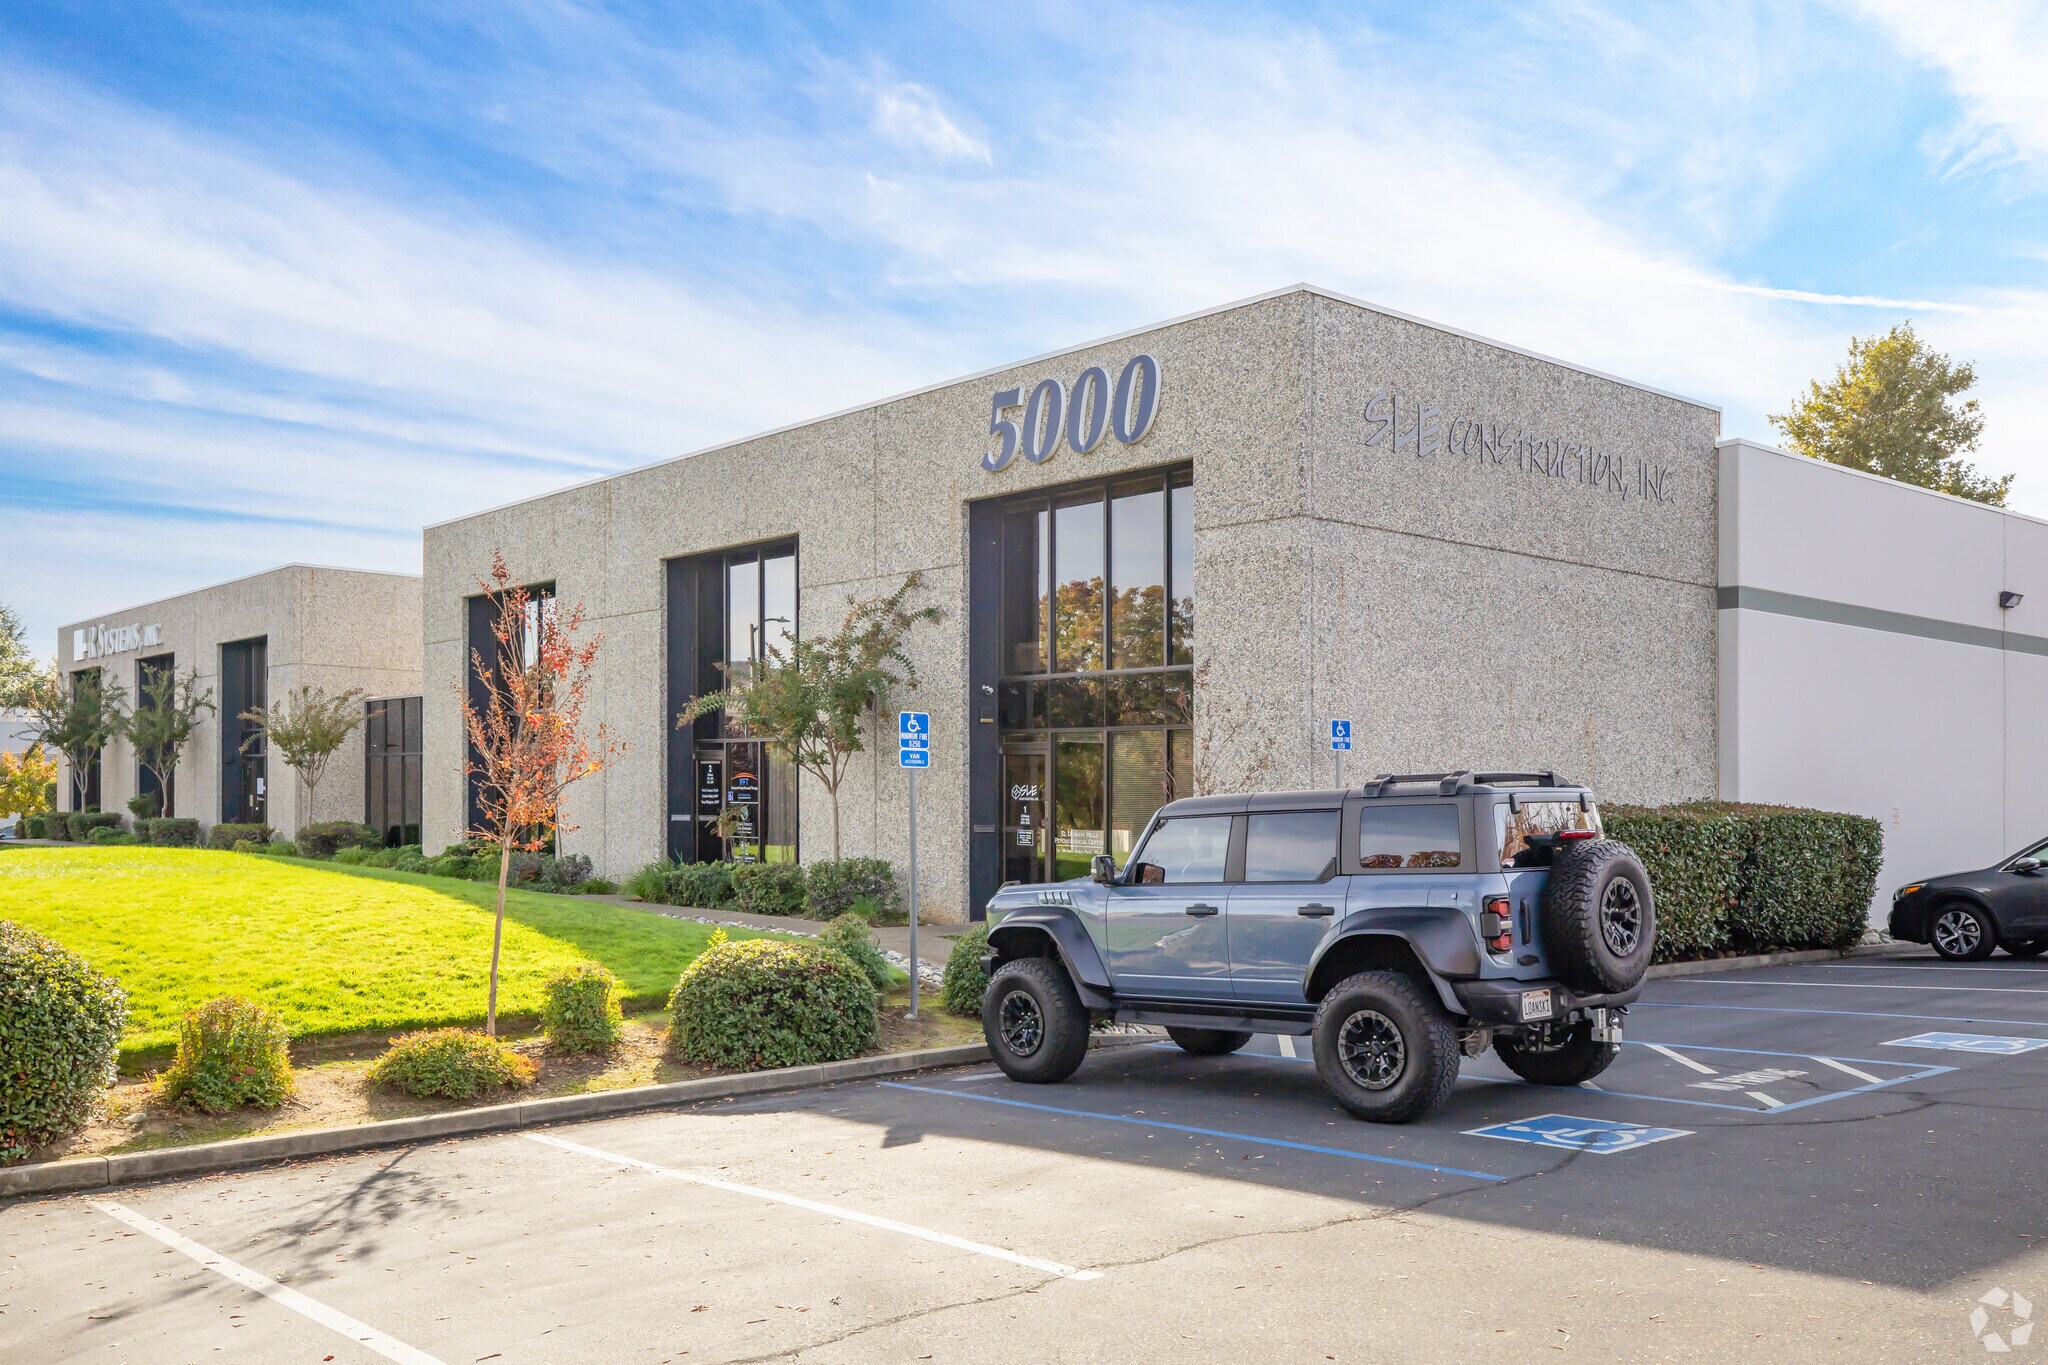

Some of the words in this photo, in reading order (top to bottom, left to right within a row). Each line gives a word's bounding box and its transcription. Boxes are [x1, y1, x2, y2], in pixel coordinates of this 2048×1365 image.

[981, 354, 1161, 472] 5000
[1365, 394, 1441, 457] SLE
[1450, 415, 1631, 500] CONSTRUCTION,
[1639, 458, 1674, 503] INC.
[1020, 785, 1037, 796] SLE
